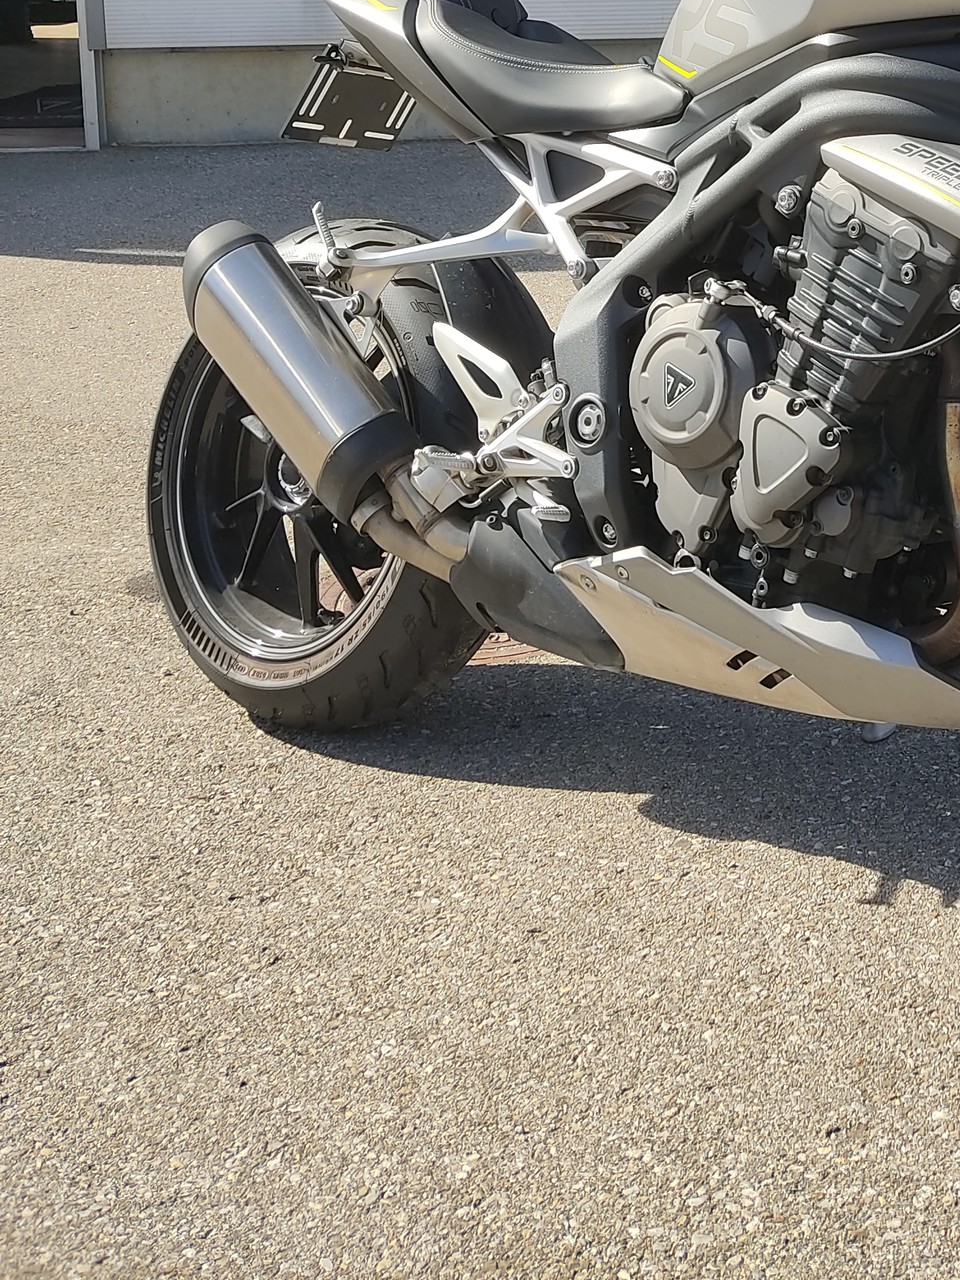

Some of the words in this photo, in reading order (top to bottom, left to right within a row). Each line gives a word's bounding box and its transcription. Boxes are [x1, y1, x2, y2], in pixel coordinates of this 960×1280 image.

[154, 375, 182, 467] MICHELIN
[361, 586, 390, 629] 190/55
[280, 880, 363, 958] MICHELIN
